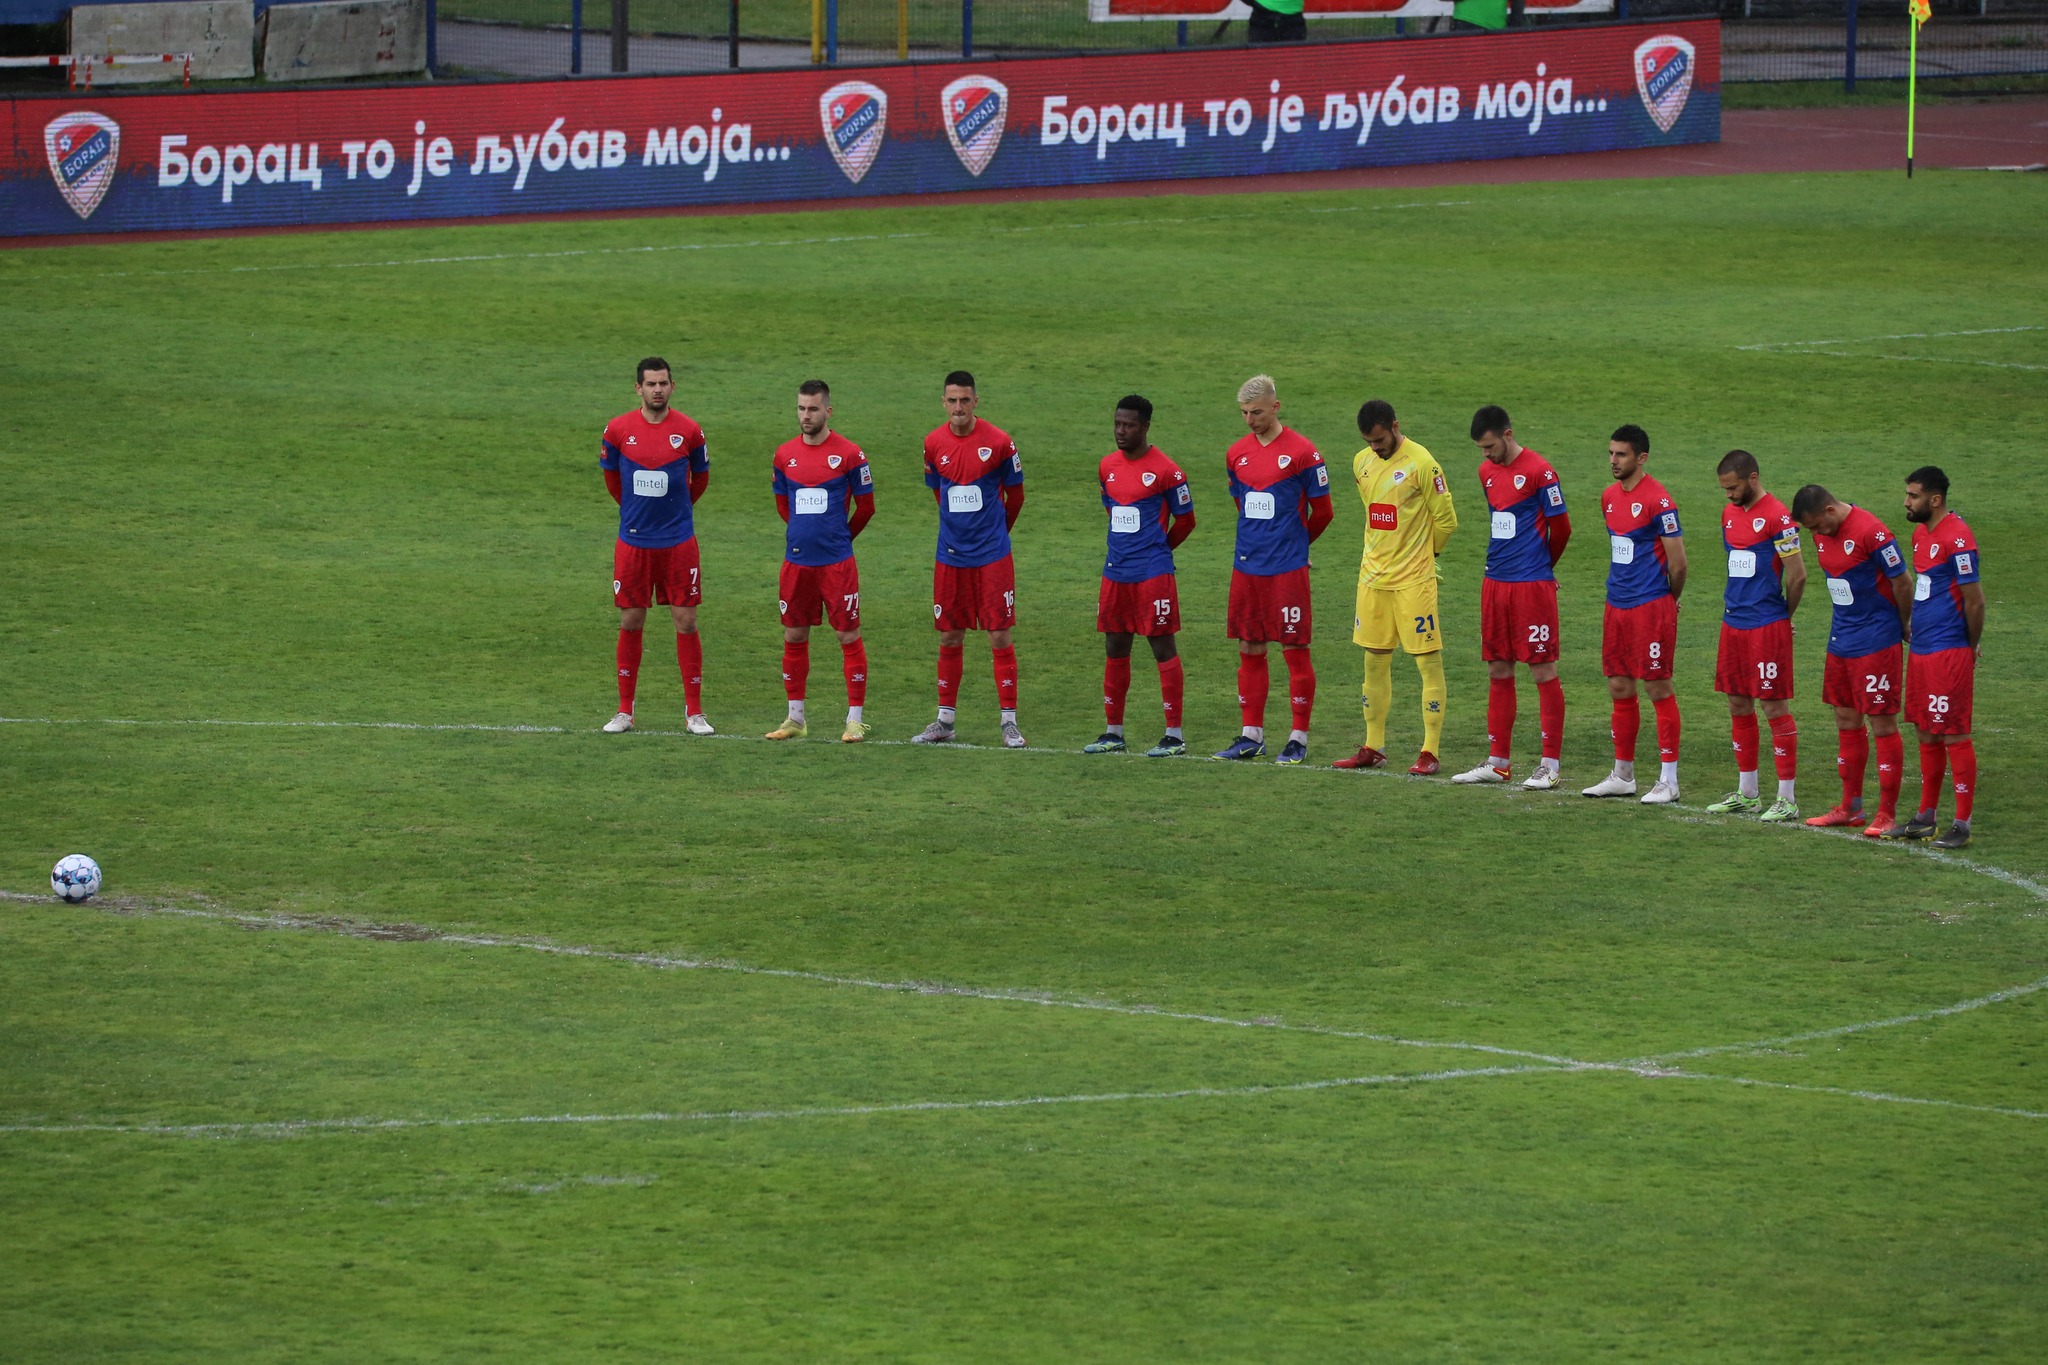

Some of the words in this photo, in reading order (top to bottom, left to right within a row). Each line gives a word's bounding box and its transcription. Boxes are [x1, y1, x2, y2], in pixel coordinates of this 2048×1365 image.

[1040, 96, 1186, 160] Борац
[1203, 99, 1253, 137] то
[1262, 79, 1304, 153] је
[1318, 75, 1460, 145] љубав
[1473, 62, 1608, 136] моја...
[158, 135, 322, 204] Борац
[342, 139, 395, 180] то
[407, 120, 453, 196] је
[471, 117, 626, 190] љубав
[642, 107, 790, 182] моја...
[636, 479, 664, 489] m:tel
[797, 495, 823, 506] m:tel
[952, 493, 978, 504] m:tel
[1247, 500, 1271, 511] m:tel
[1114, 514, 1136, 525] m:tel
[1371, 512, 1395, 522] m:tel
[1730, 558, 1751, 569] m:tel
[689, 567, 698, 585] 7
[843, 591, 859, 611] 77
[1001, 589, 1015, 608] 16
[1153, 598, 1171, 616] 15
[1281, 606, 1301, 623] 19
[1414, 614, 1435, 633] 21
[1528, 624, 1550, 642] 28
[1649, 642, 1661, 659] 8
[1756, 662, 1778, 680] 18
[1866, 673, 1891, 693] 24
[1928, 694, 1949, 712] 26
